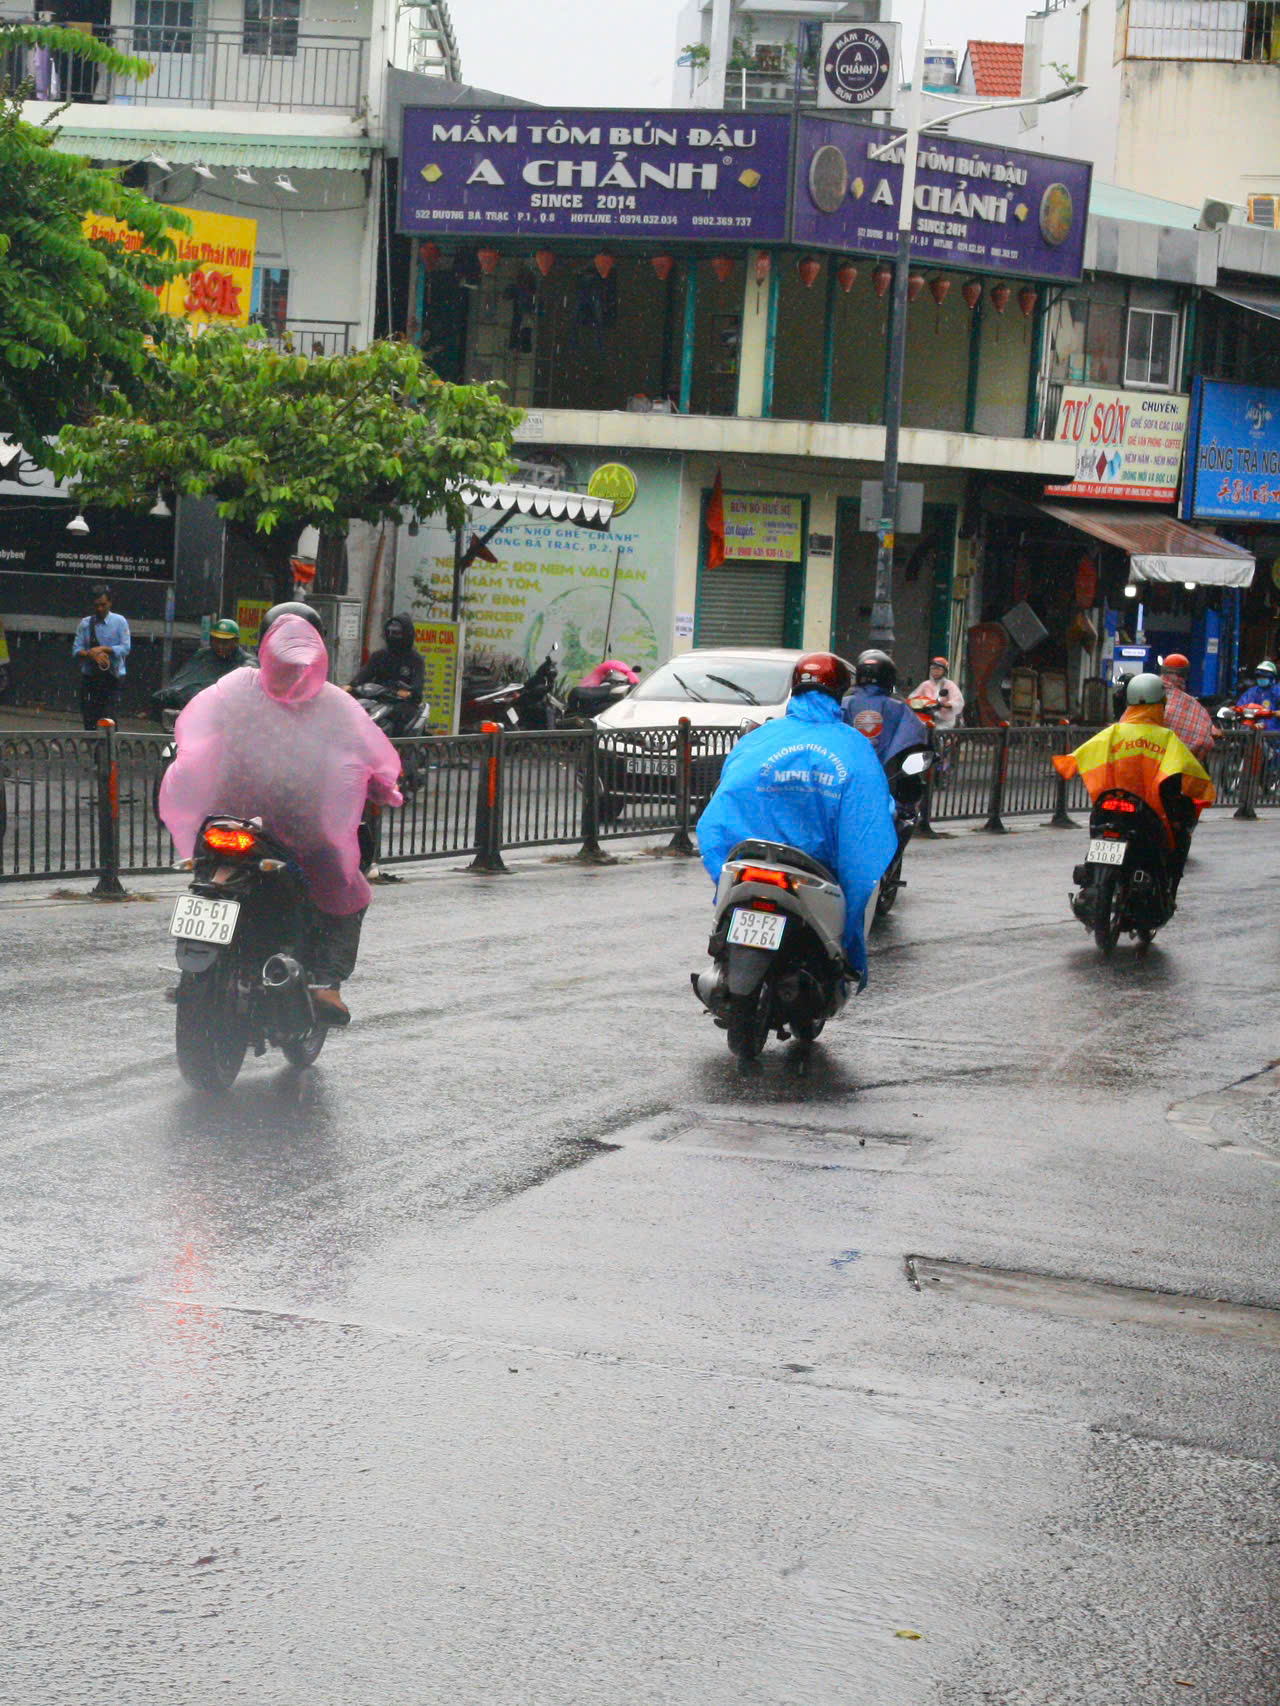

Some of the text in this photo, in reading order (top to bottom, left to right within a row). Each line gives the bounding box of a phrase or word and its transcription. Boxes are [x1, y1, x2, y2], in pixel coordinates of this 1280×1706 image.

[854, 51, 862, 62] A
[432, 114, 756, 152] MẮM TÔM BÚN ĐẬU
[466, 151, 718, 190] A CHẢNH
[917, 146, 955, 173] TÔM
[955, 154, 991, 179] BÚN
[991, 161, 1028, 188] ĐẬU
[531, 193, 636, 209] SINCE 2014
[871, 178, 1008, 224] A CHẢNH
[1261, 449, 1280, 475] NG
[774, 770, 810, 783] MINH
[183, 898, 229, 921] 36-G1
[739, 911, 778, 932] 59-F2
[174, 916, 230, 941] 300.78
[731, 927, 776, 947] 417.64
